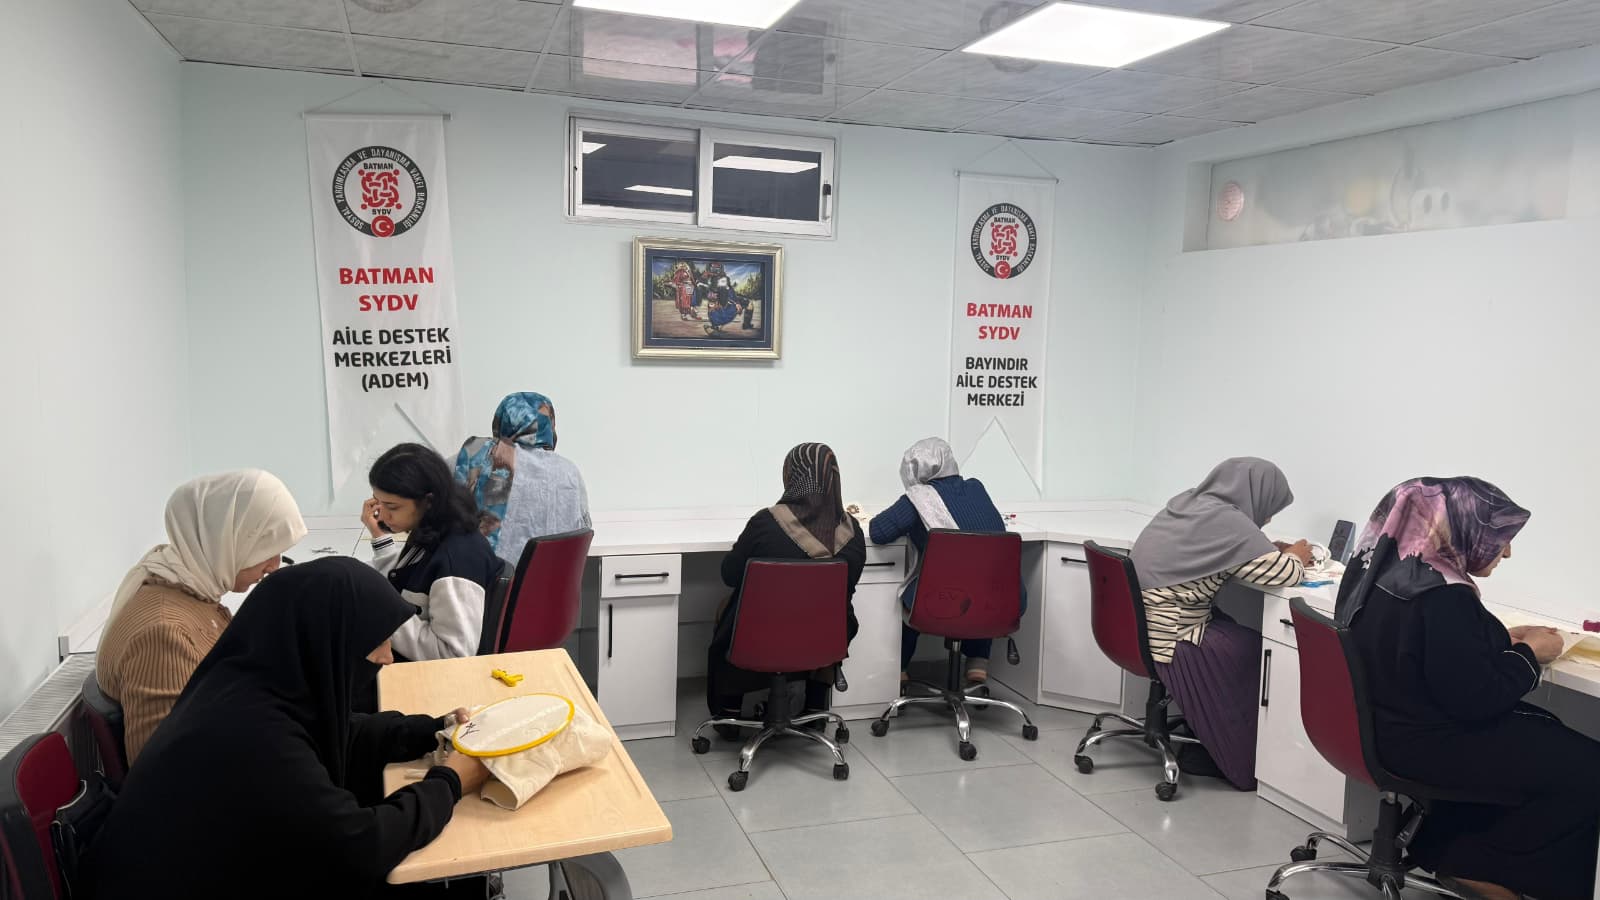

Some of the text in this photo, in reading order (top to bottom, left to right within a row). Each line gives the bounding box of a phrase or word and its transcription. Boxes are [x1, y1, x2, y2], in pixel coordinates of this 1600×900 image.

[357, 150, 368, 160] VE
[363, 162, 394, 170] BATMAN
[339, 267, 435, 285] BATMAN
[358, 294, 418, 312] SYDV
[966, 303, 1033, 318] BATMAN
[332, 326, 450, 345] AİLE DESTEK
[978, 325, 1021, 340] SYDV
[334, 345, 452, 367] MERKEZLERİ
[965, 356, 1029, 371] BAYINDIR
[361, 371, 429, 392] (ADEM)
[956, 371, 1038, 389] AİLE DESTEK
[967, 391, 1025, 406] MERKEZİ
